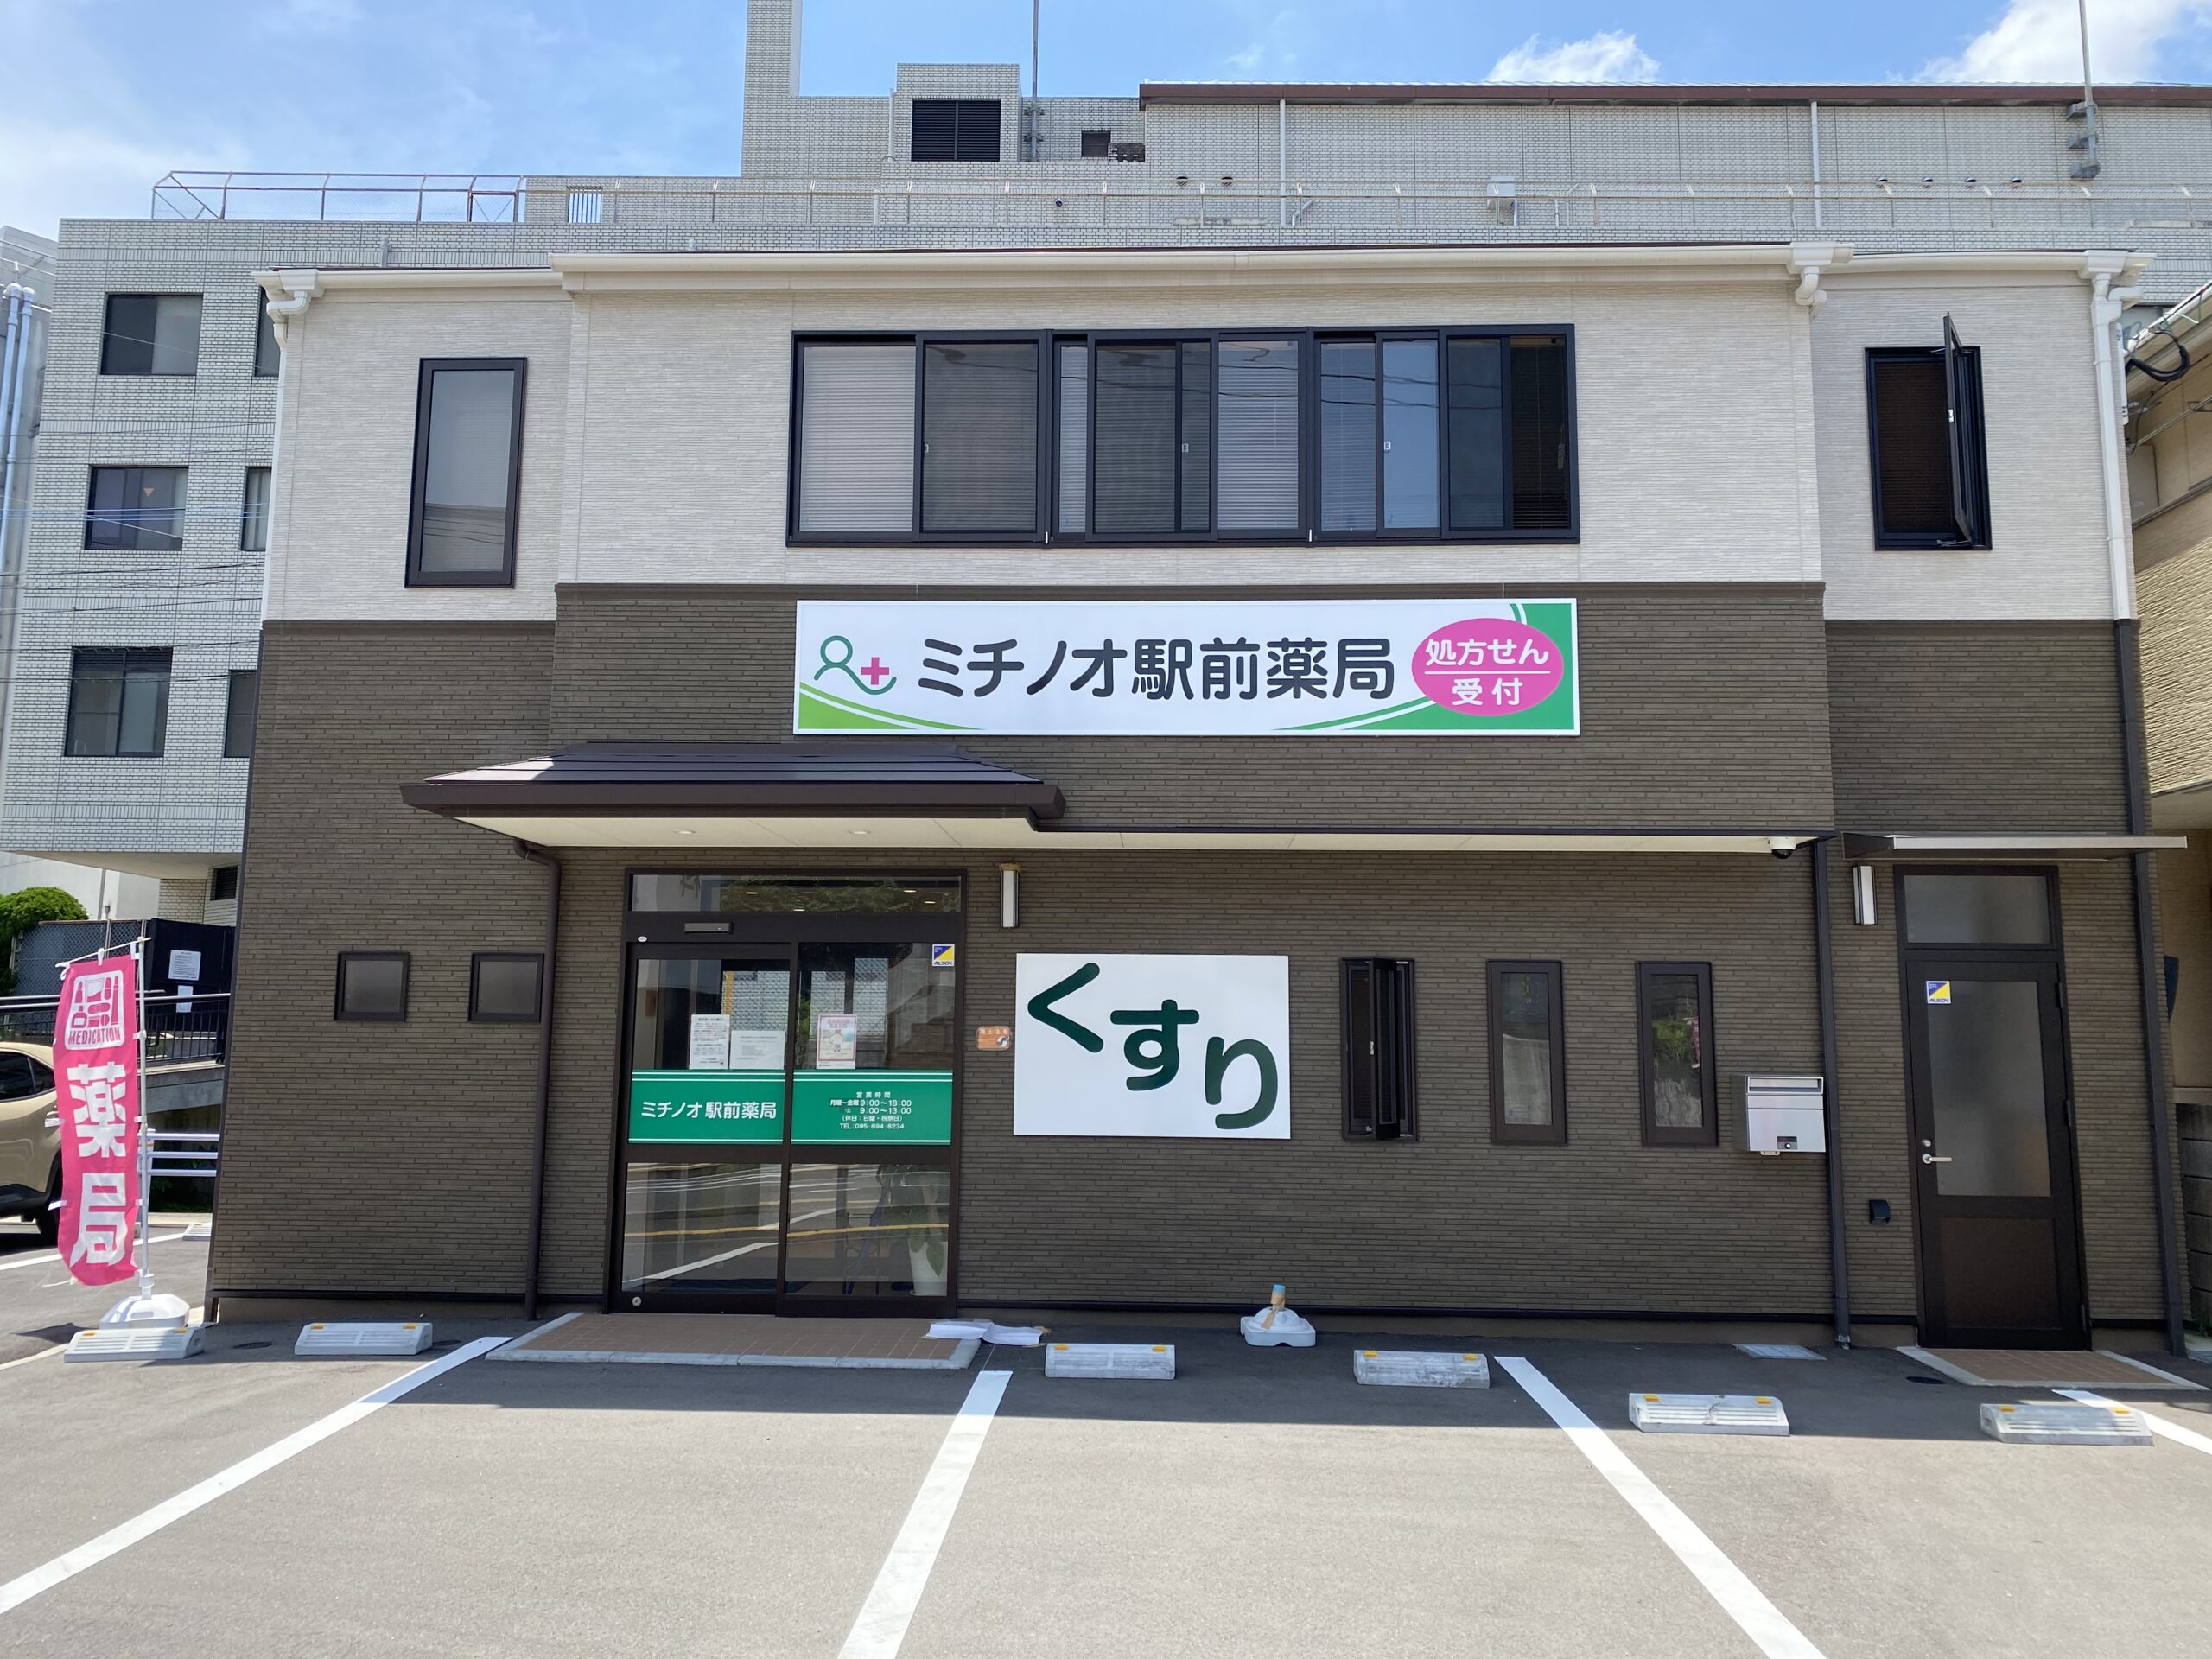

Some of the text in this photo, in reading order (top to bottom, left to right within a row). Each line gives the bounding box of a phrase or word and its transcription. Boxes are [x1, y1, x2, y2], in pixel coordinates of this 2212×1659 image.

[1425, 638, 1549, 666] 処方せん
[918, 636, 1395, 701] ミチノオ駅前薬局
[1452, 677, 1523, 706] 受付
[68, 1027, 121, 1045] MEDICATION
[1027, 962, 1278, 1130] くすり
[641, 1101, 777, 1119] ミチノオ駅前薬局
[67, 1062, 126, 1266] 薬局
